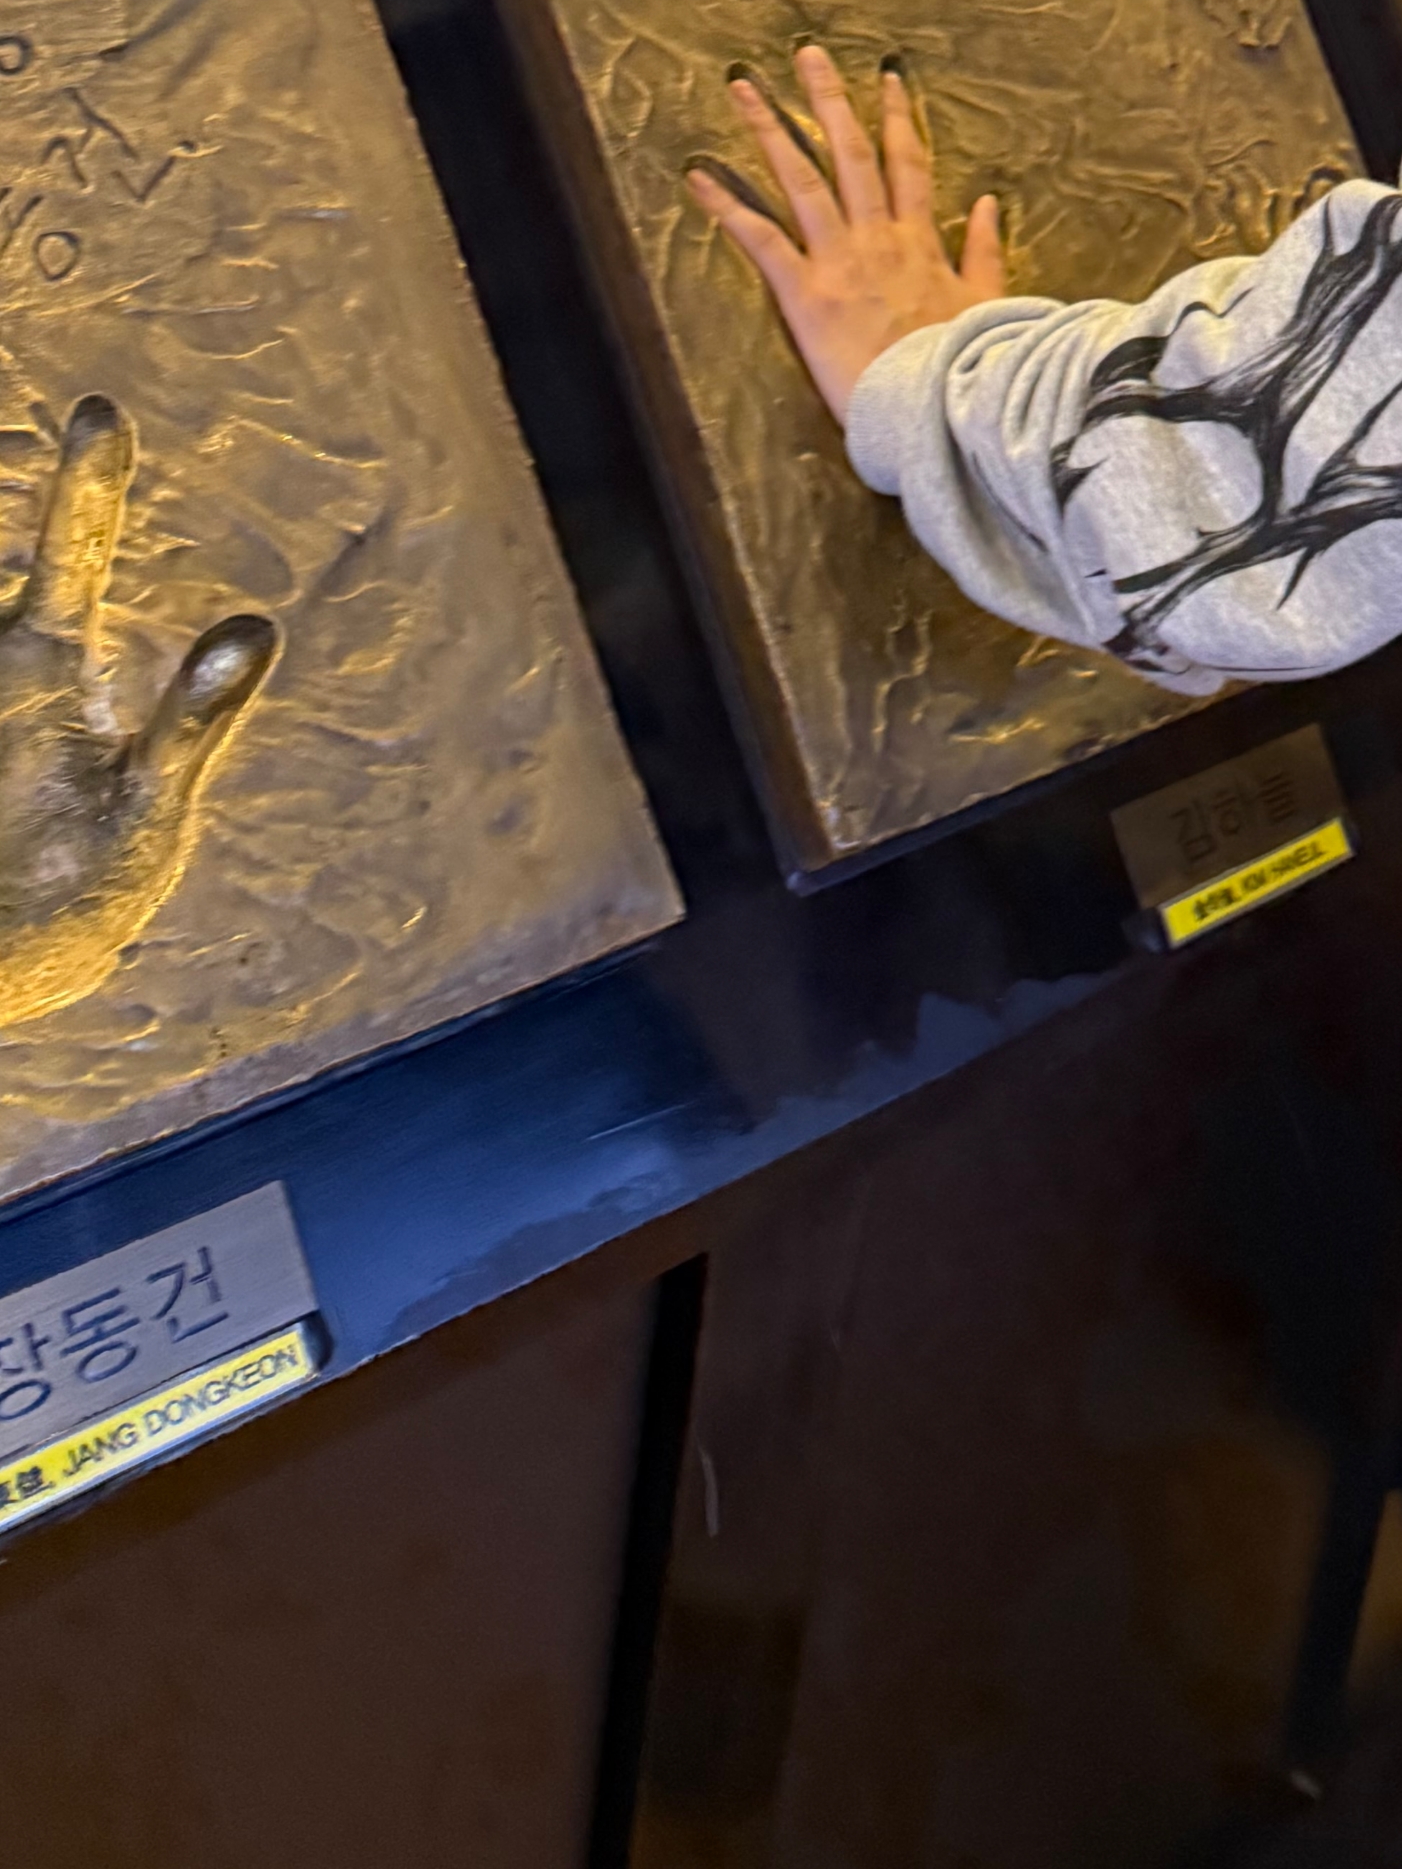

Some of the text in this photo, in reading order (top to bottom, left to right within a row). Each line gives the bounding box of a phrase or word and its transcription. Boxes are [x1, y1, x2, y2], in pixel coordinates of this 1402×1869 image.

[1169, 770, 1298, 864] 김하늘
[63, 1342, 300, 1478] JANG DONGKEON
